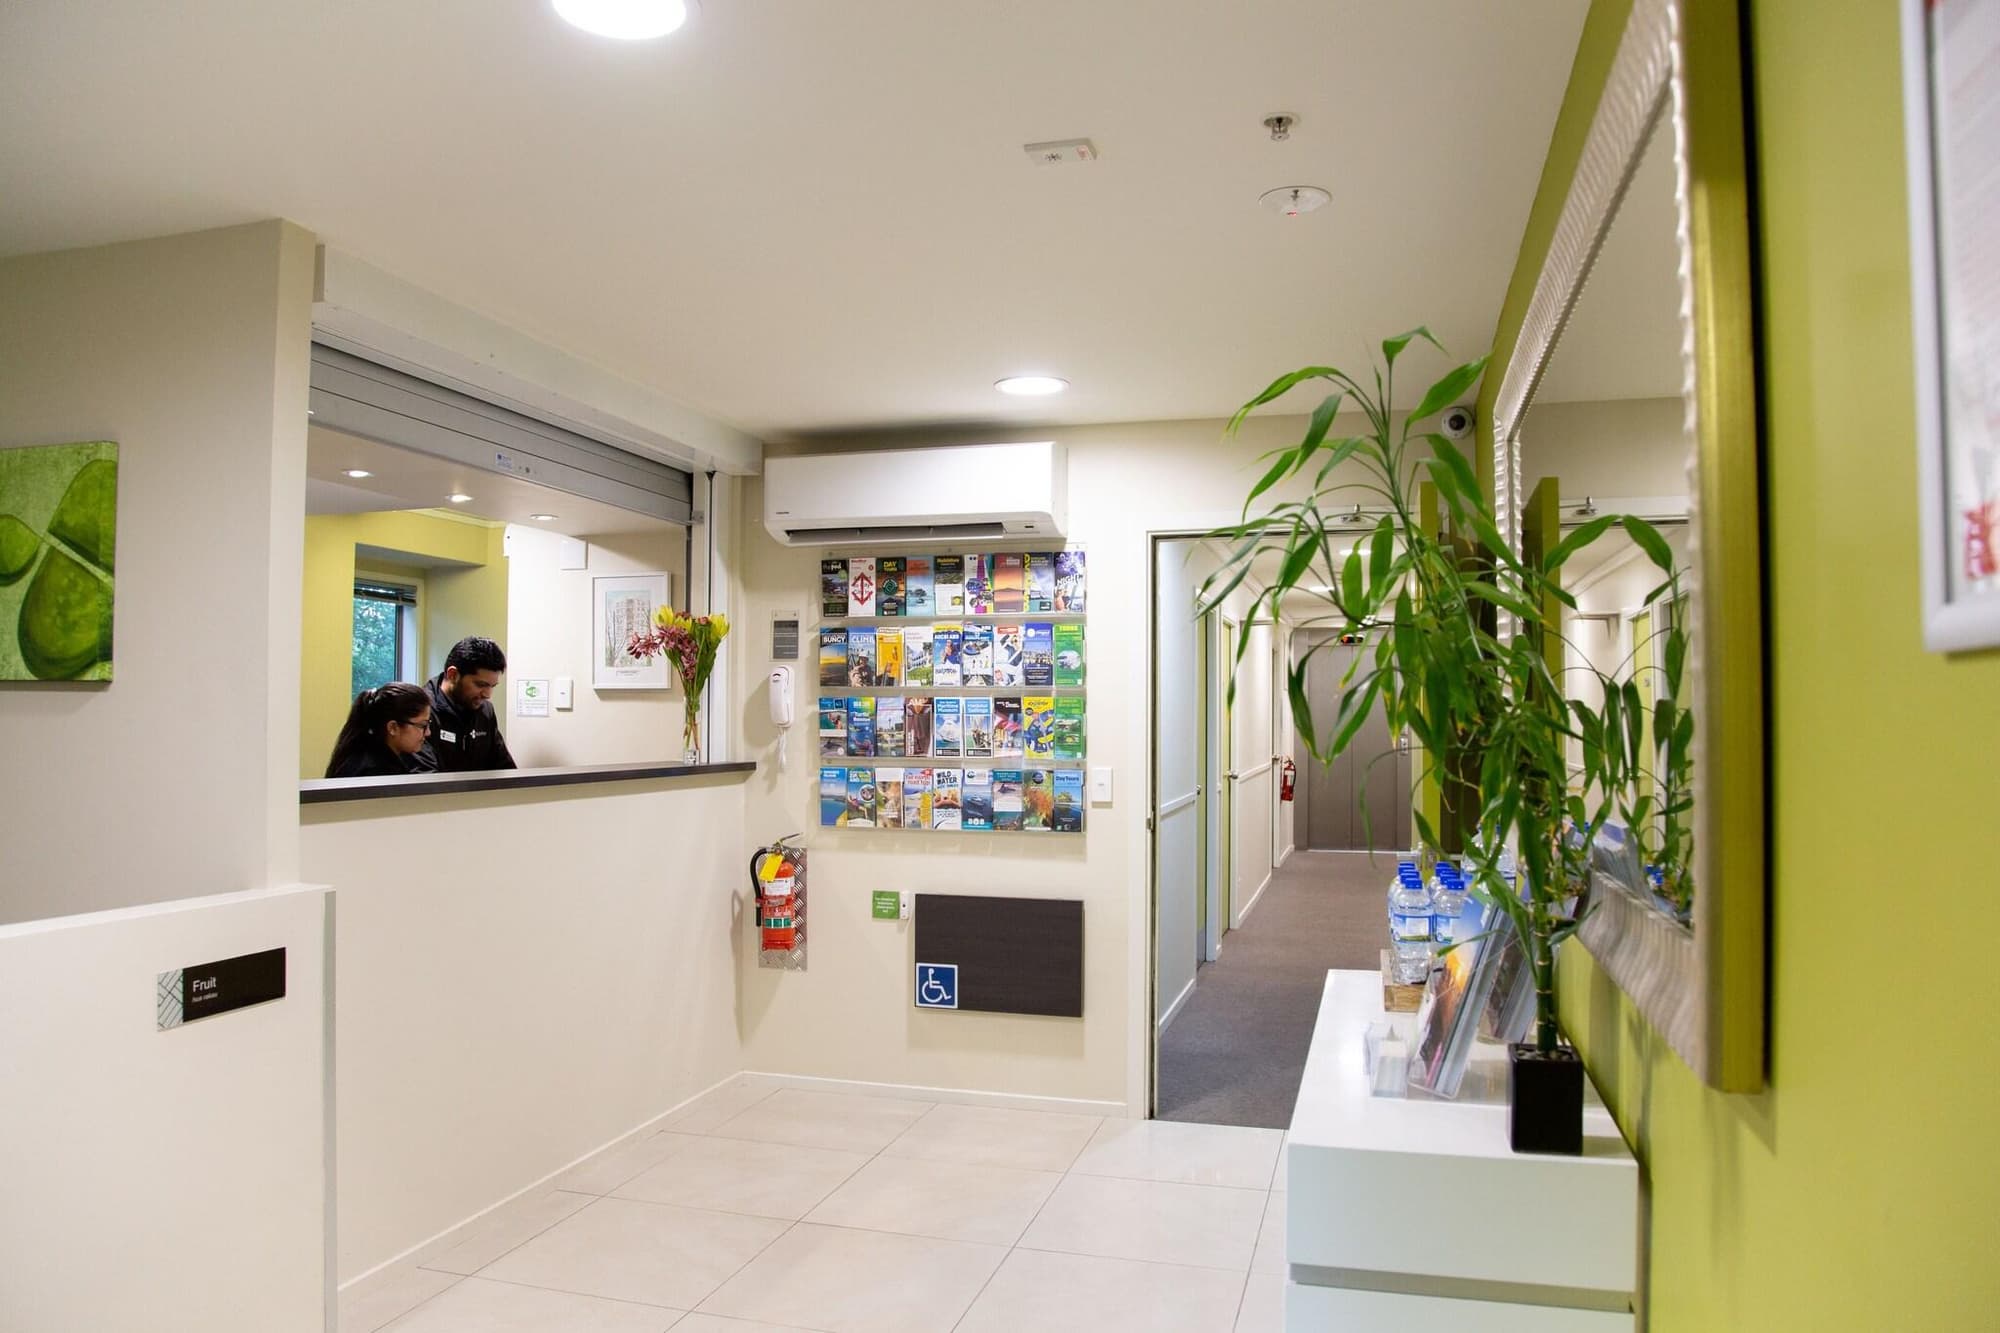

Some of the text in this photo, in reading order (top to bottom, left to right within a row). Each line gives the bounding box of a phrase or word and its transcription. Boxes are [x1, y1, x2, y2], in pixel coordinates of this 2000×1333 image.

[936, 771, 952, 779] WILD
[937, 777, 957, 785] WATER
[192, 976, 217, 993] Fruit
